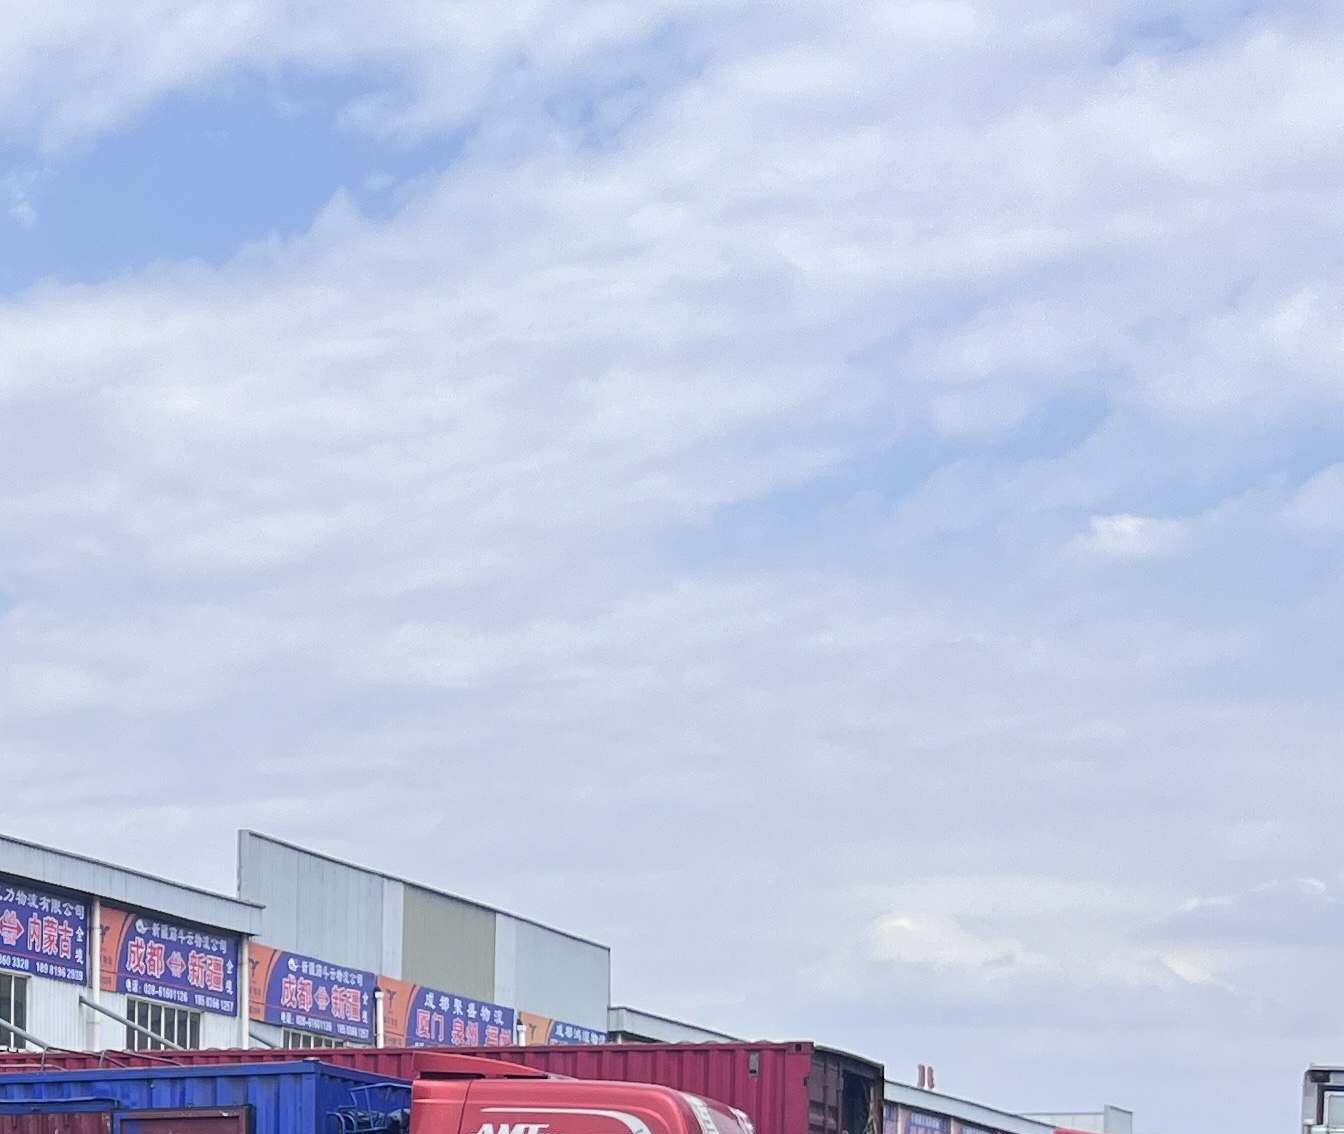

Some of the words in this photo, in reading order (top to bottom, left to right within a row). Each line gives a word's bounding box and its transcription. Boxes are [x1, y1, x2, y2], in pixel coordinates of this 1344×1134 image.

[27, 912, 74, 960] 内蒙古
[126, 937, 165, 978] 成都
[187, 950, 224, 992] 新疆
[281, 974, 313, 1012] 成都
